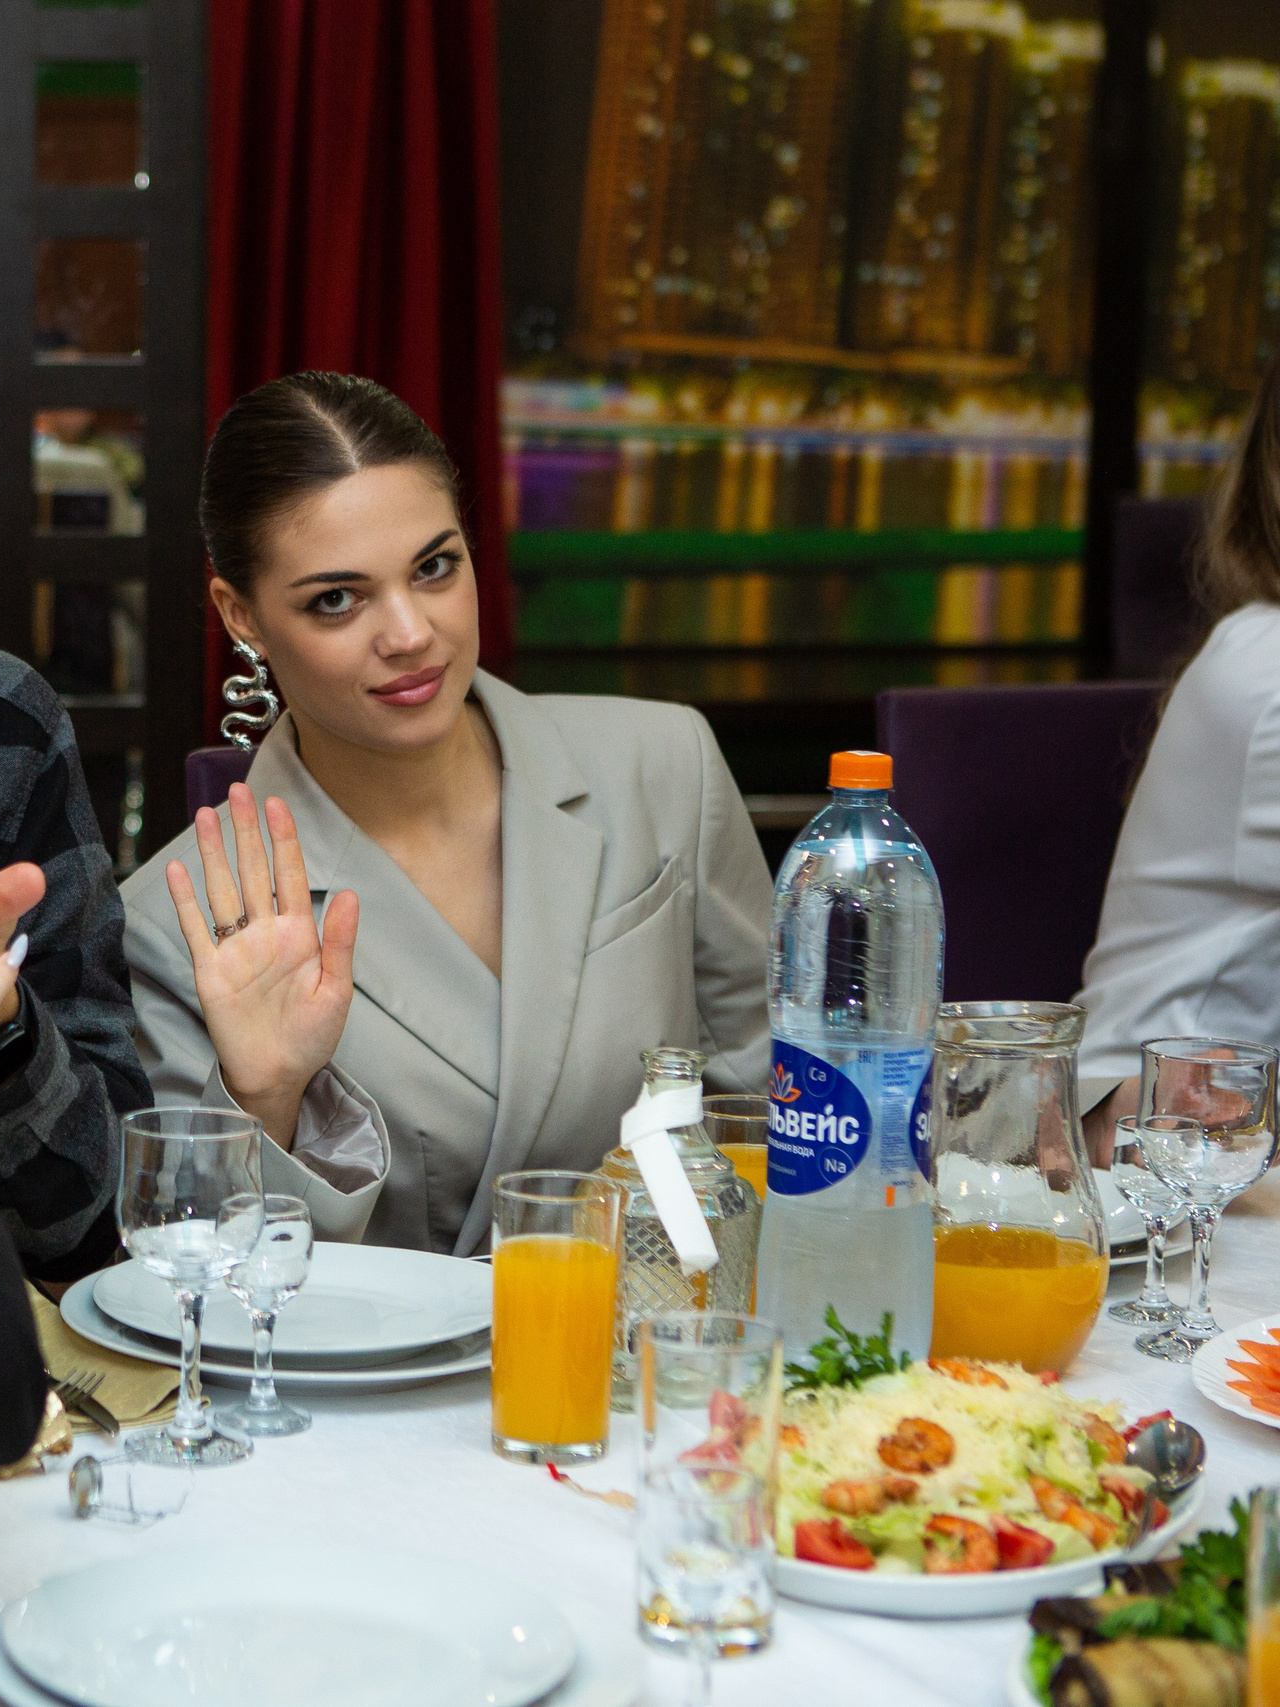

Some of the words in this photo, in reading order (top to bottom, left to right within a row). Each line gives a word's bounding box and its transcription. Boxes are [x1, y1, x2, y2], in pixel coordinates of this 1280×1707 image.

[809, 1067, 827, 1082] Ca
[792, 1144, 815, 1158] ВОДА
[824, 1157, 847, 1174] Na
